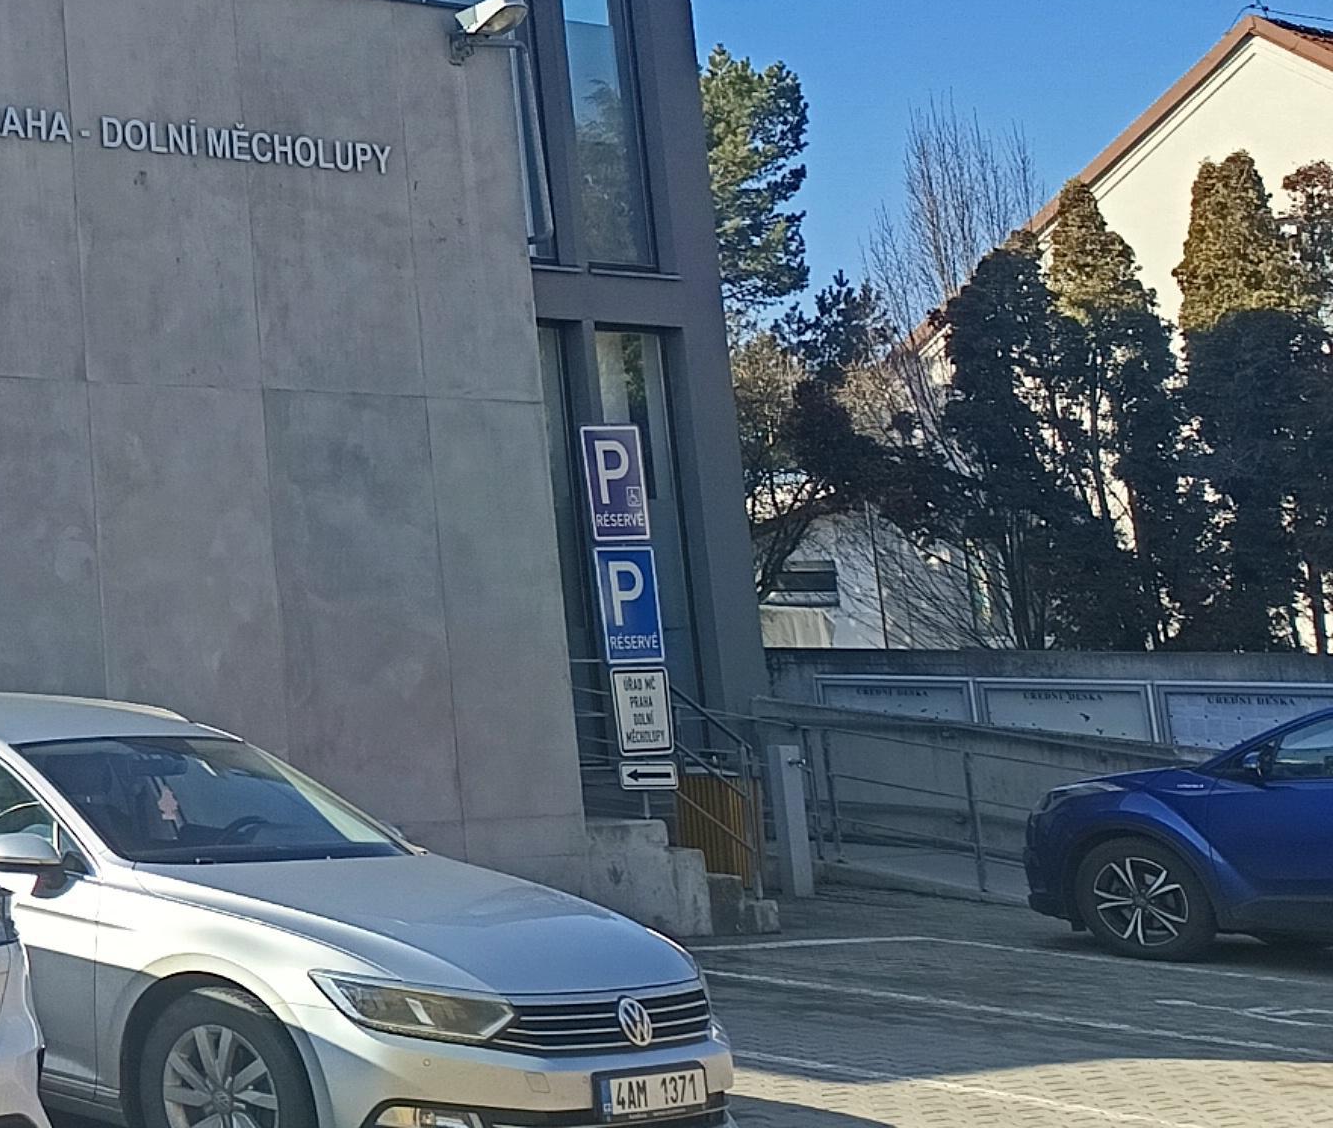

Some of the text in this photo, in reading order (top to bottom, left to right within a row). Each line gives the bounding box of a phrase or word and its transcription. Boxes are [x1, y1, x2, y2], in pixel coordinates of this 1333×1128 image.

[80, 126, 91, 139] -
[101, 117, 199, 156] DOLNÍ
[207, 123, 391, 174] MĚCHOLUPY
[594, 440, 629, 505] P
[596, 510, 645, 527] RÉSERVÉ
[608, 560, 644, 627] P
[609, 632, 659, 650] RÉSERVÉ
[616, 1073, 697, 1110] 4AM 1371
